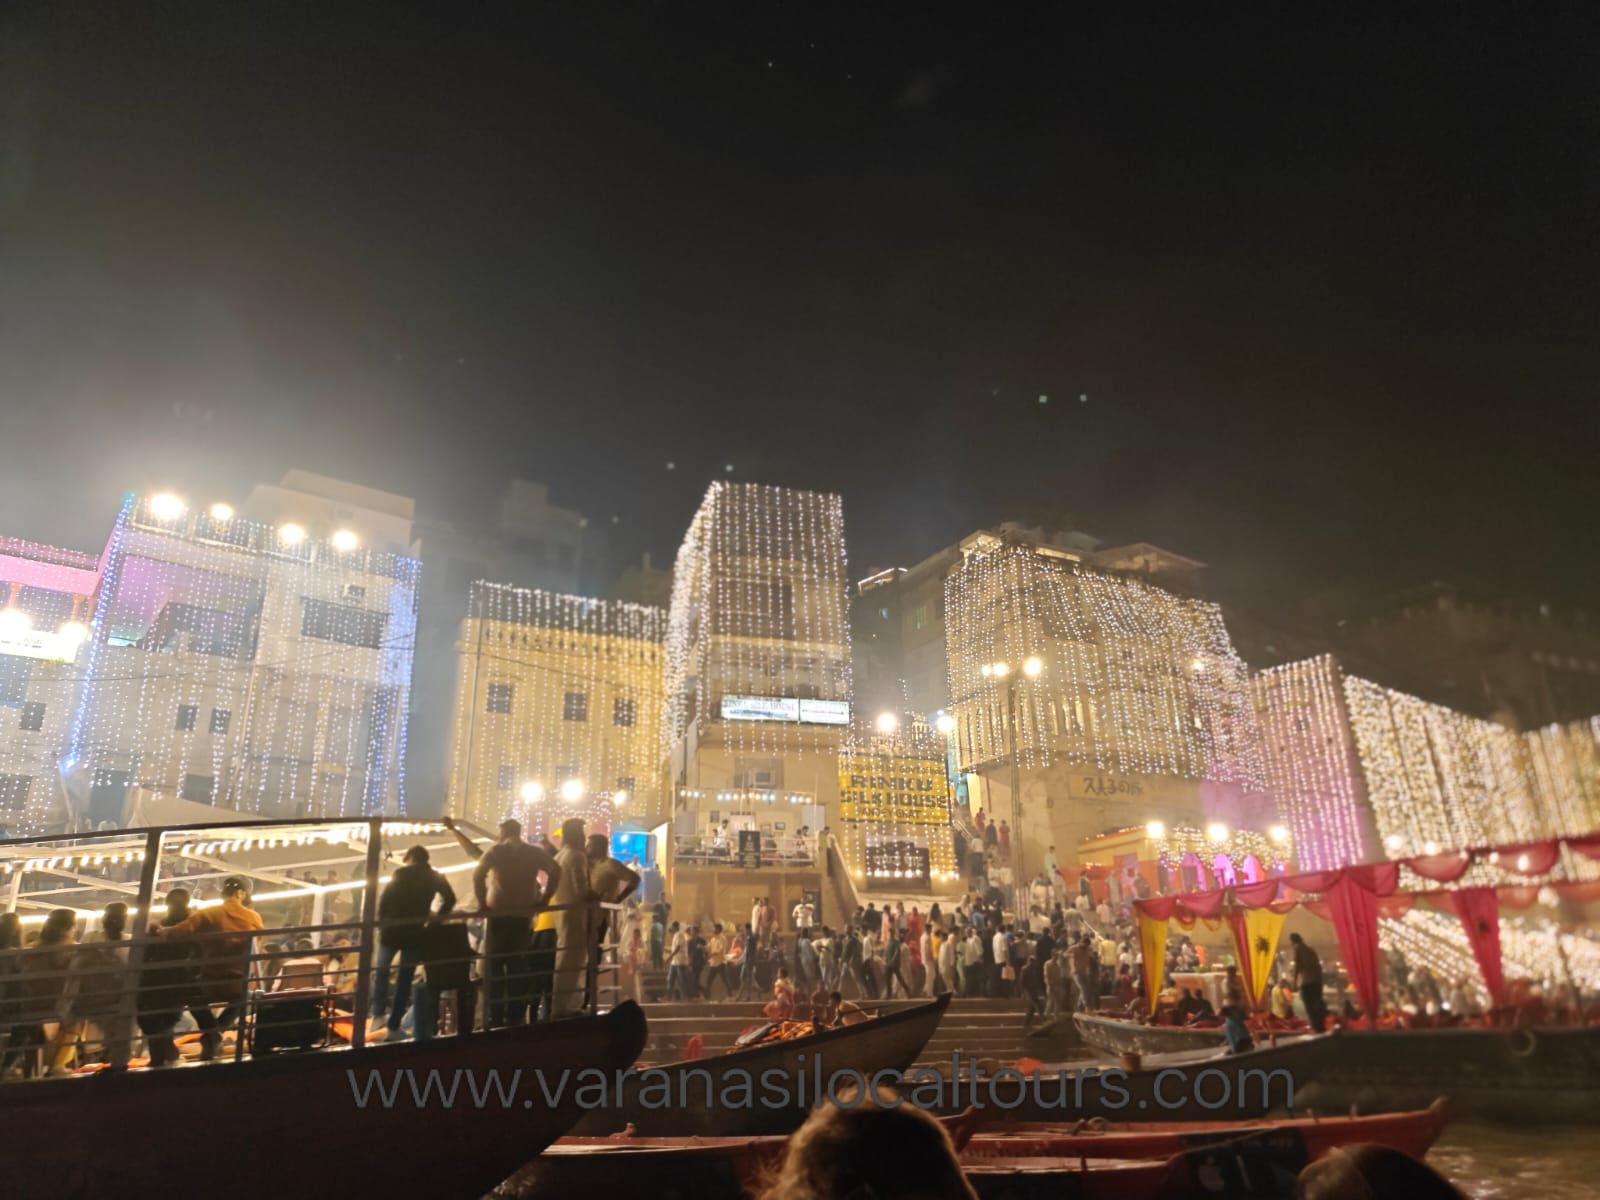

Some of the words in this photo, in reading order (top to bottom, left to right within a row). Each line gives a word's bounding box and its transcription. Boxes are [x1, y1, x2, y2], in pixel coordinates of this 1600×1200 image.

[850, 775, 933, 792] RINKU
[840, 790, 882, 805] SILK
[886, 792, 947, 808] HOUSE
